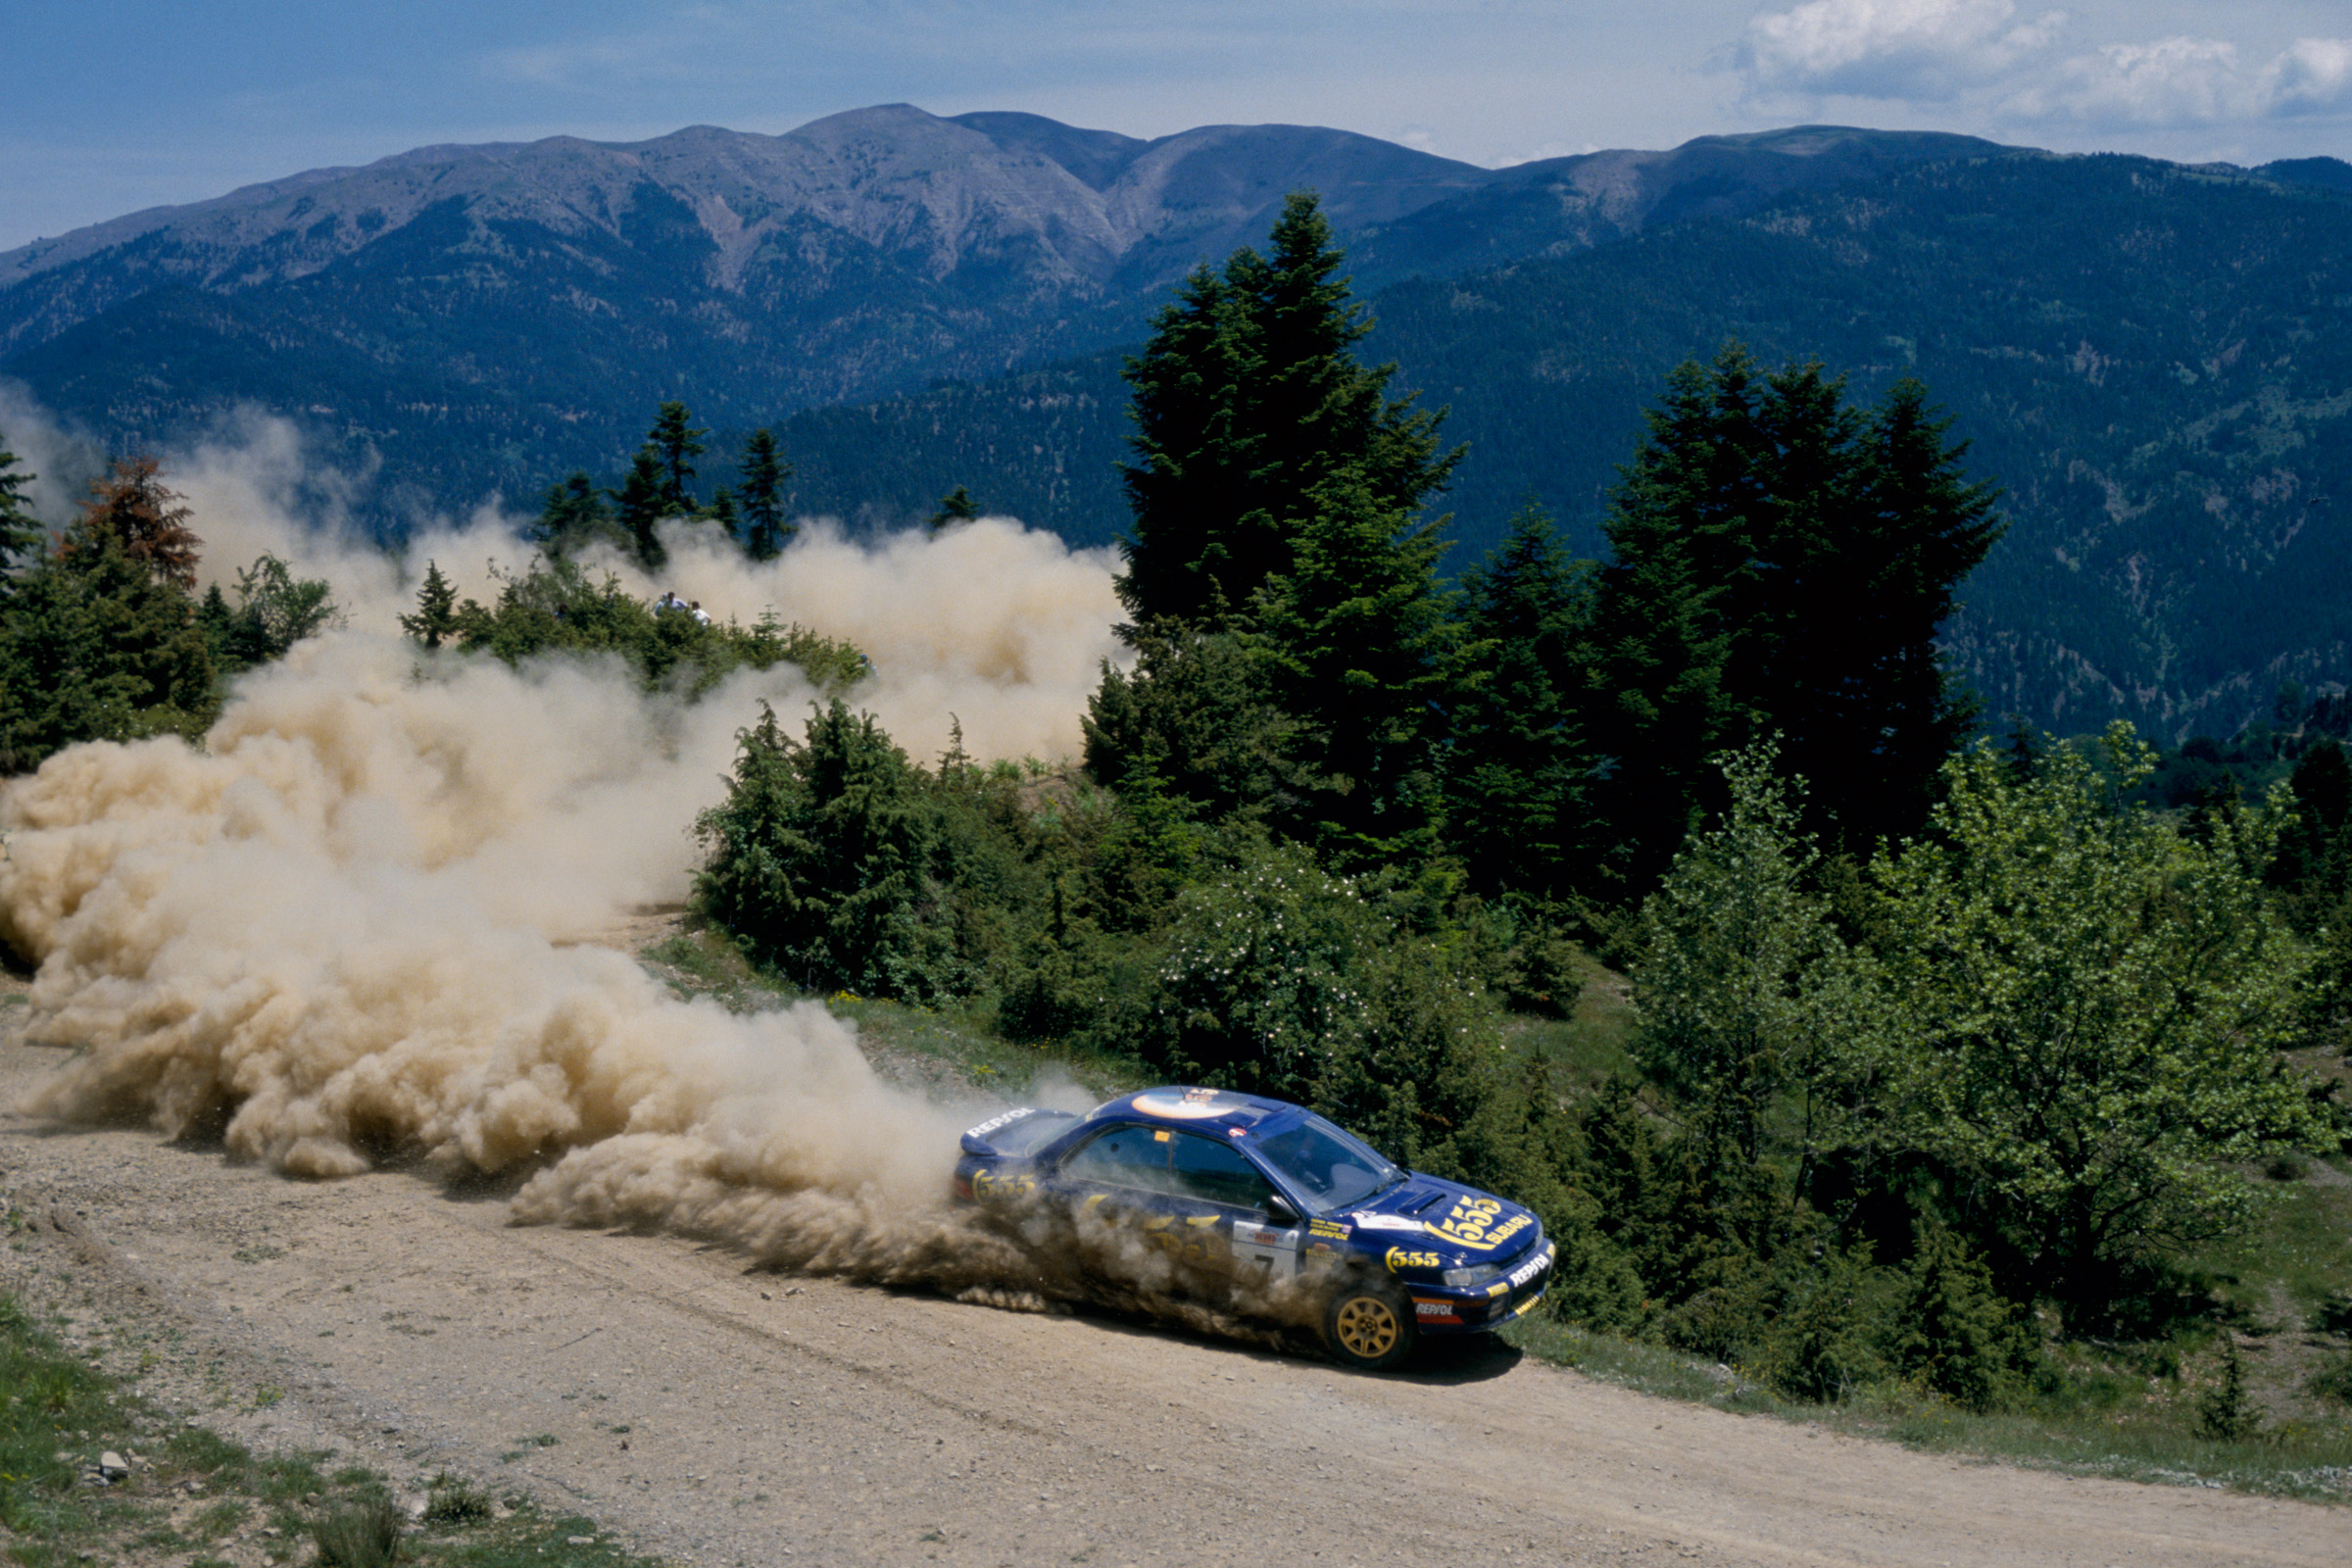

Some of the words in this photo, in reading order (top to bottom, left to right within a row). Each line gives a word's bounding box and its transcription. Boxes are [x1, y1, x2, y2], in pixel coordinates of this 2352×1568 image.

[966, 1107, 1036, 1138] REPSOL
[1442, 1195, 1501, 1241] 555
[1485, 1213, 1533, 1245] SUBARU
[1392, 1250, 1441, 1267] 555
[1509, 1253, 1550, 1288] REPSOL
[1416, 1302, 1453, 1315] REPSOL
